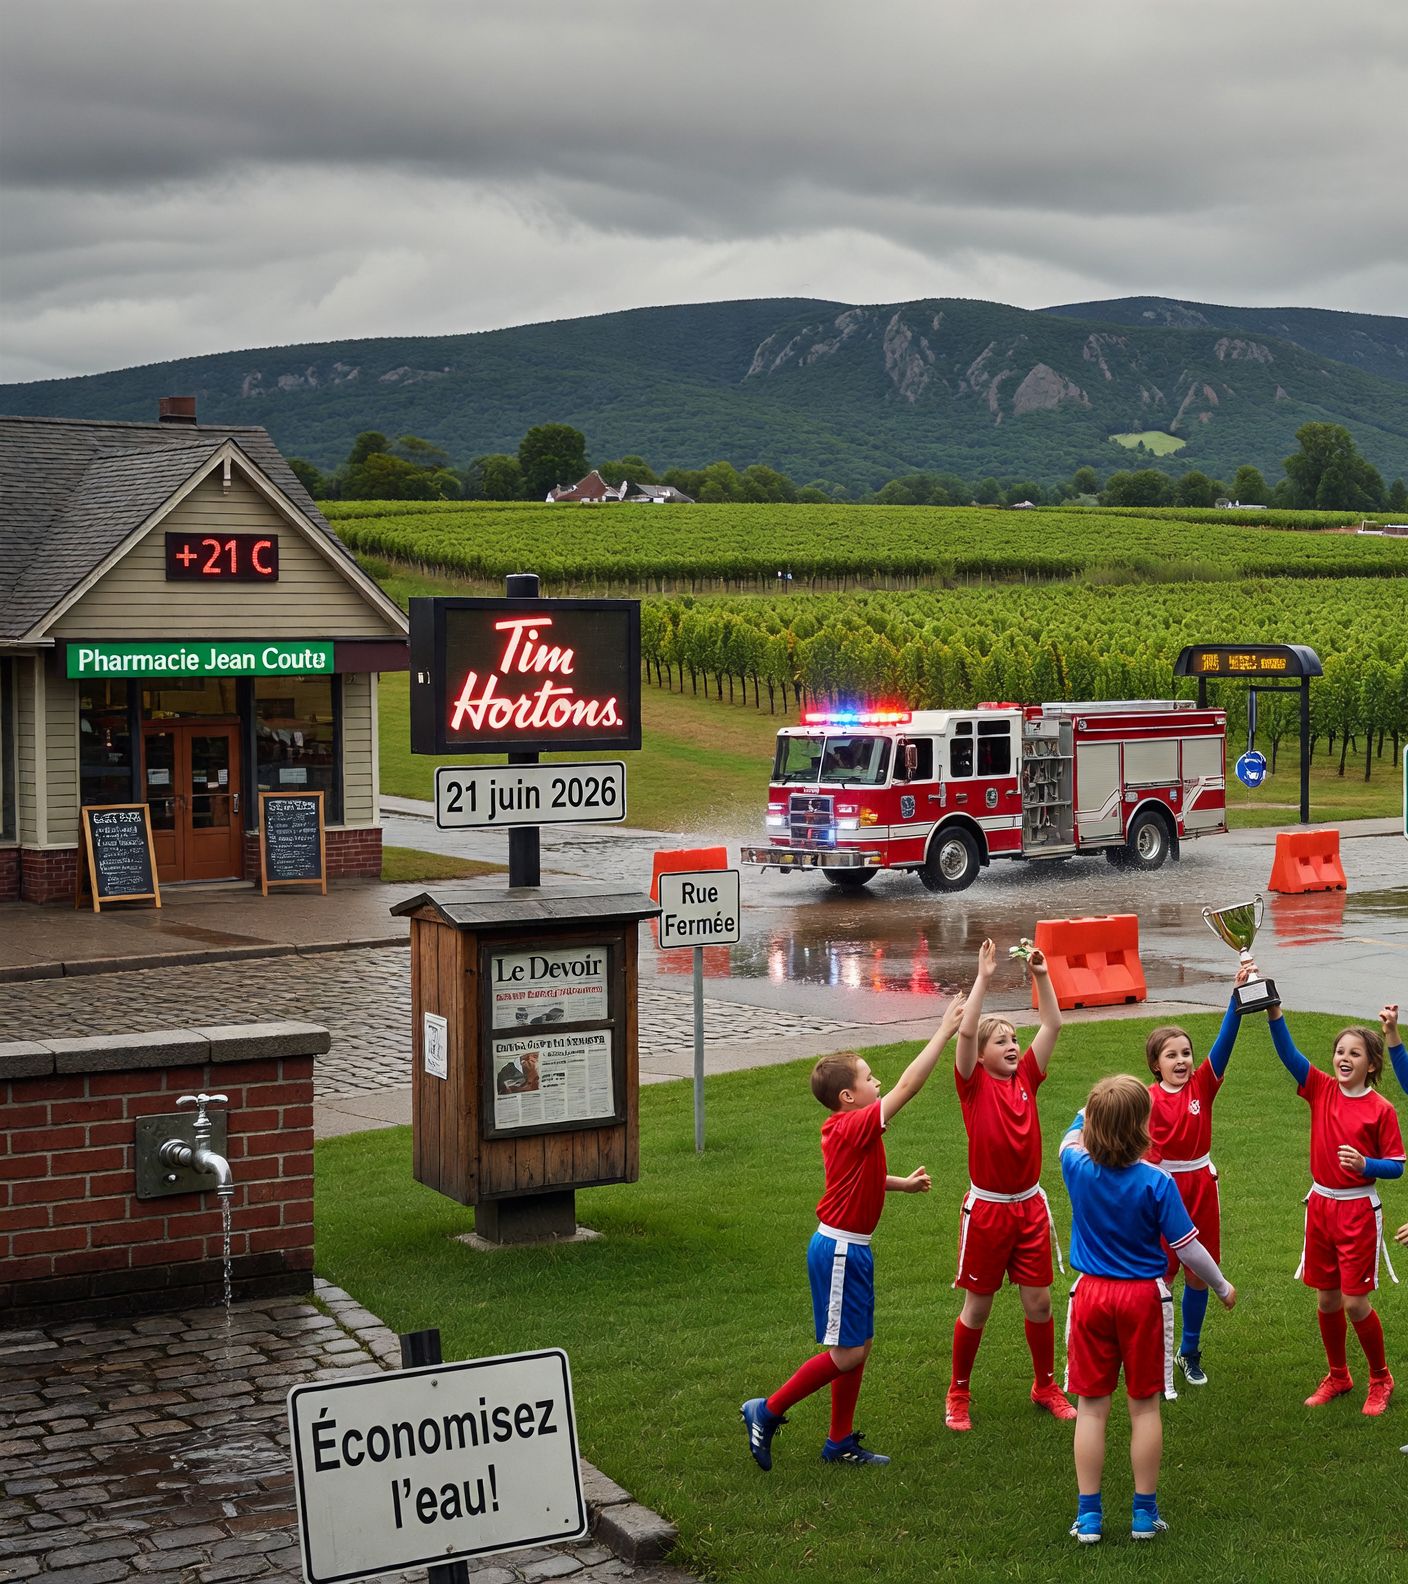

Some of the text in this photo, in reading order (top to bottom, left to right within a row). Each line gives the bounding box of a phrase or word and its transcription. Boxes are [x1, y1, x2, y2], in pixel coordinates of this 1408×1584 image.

[176, 538, 273, 574] +21 C
[78, 648, 199, 672] Pharmacie
[204, 648, 256, 670] Jean
[495, 617, 574, 675] Tim
[446, 776, 616, 820] 21 juin 2026
[682, 882, 718, 904] Rue
[665, 911, 735, 936] Fermée
[496, 954, 602, 982] Le Devoir
[311, 1396, 558, 1473] Économisez
[391, 1464, 500, 1529] l'eau!
